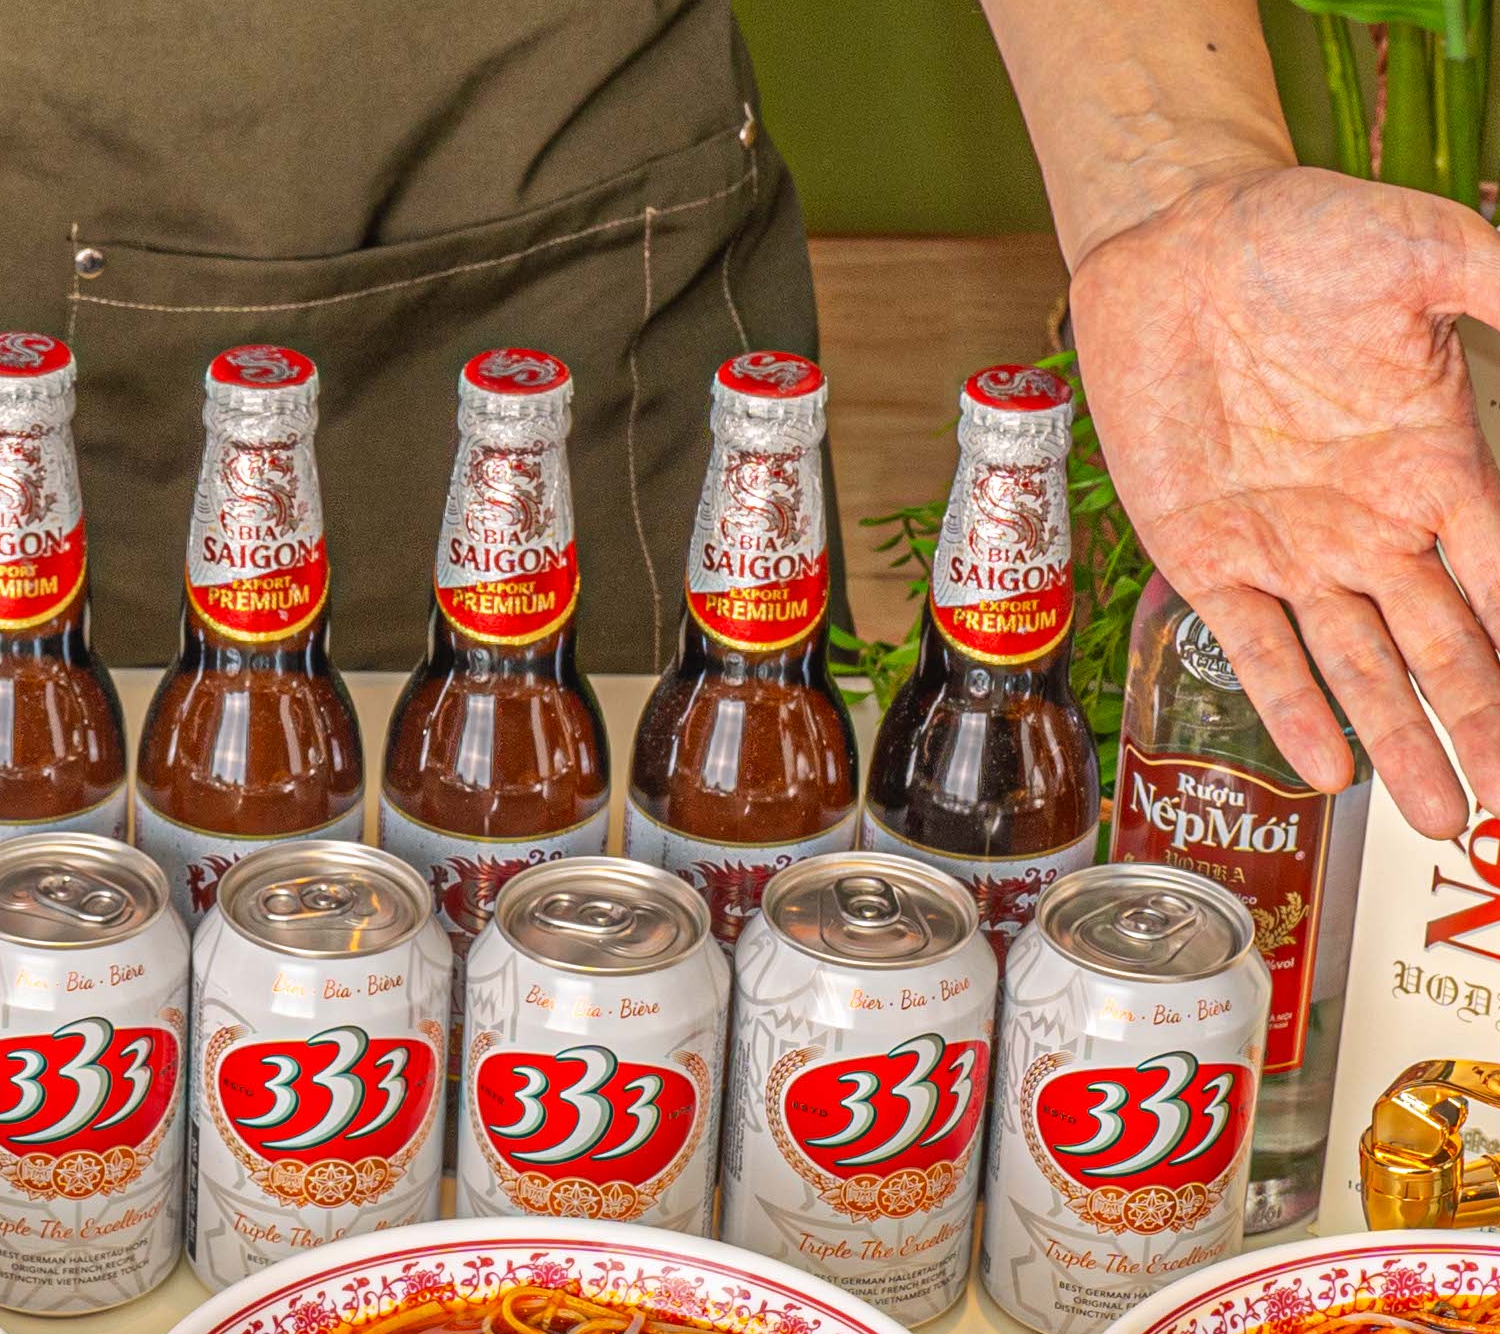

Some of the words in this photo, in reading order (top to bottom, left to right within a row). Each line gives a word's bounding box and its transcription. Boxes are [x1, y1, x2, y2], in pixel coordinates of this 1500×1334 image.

[238, 525, 277, 541] BIA
[484, 529, 522, 545] BIA
[739, 534, 778, 553] BIA
[203, 535, 316, 569] SAIGON
[449, 537, 563, 573] SAIGON
[702, 542, 817, 580] SAIGON
[988, 547, 1028, 564] BIA
[232, 575, 292, 590] EXPORT
[949, 556, 1064, 591] SAIGON
[208, 585, 310, 611] PREMIUM
[476, 581, 536, 595] EXPORT
[729, 587, 790, 601] EXPORT
[452, 589, 556, 615] PREMIUM
[705, 594, 808, 621] PREMIUM
[979, 599, 1039, 613] EXPORT
[953, 608, 1056, 633] PREMIUM
[1177, 771, 1245, 807] Rượu
[67, 970, 94, 992] Bia
[110, 964, 145, 987] Bière
[323, 978, 351, 1000] Bia
[368, 974, 404, 997] Bière
[619, 997, 660, 1019] Bière
[849, 989, 884, 1010] Bier
[901, 988, 927, 1010] Bia
[1153, 1002, 1182, 1026] Bia
[1197, 998, 1232, 1022] Bière
[235, 1025, 410, 1150] 333
[805, 1033, 976, 1167] 333
[489, 1045, 664, 1164] 333
[1054, 1051, 1234, 1177] 333
[40, 1219, 73, 1239] The
[233, 1211, 282, 1244] Triple
[289, 1227, 323, 1247] The
[21, 1254, 66, 1264] GERMAN
[69, 1247, 124, 1263] HALLERTAU
[126, 1237, 148, 1254] HOPS
[247, 1253, 269, 1265] BEST
[799, 1232, 852, 1261] Triple
[860, 1240, 894, 1260] The
[1044, 1237, 1097, 1269] Triple
[1105, 1253, 1140, 1274] The
[11, 1263, 60, 1275] ORIGINAL
[62, 1263, 103, 1275] FRENCH
[105, 1254, 135, 1269] RECIPE
[56, 1271, 118, 1286] VIETNAMESE
[120, 1259, 150, 1276] TOUCH
[841, 1273, 885, 1285] GERMAN
[888, 1264, 938, 1283] HALLERTAU
[847, 1284, 879, 1295] GINAL
[881, 1282, 920, 1295] FRENCH
[921, 1268, 947, 1285] RECIPE
[1058, 1281, 1082, 1294] BEST
[1085, 1288, 1131, 1299] GERMAN
[875, 1287, 931, 1305] VIETNAMESE
[1073, 1296, 1123, 1310] ORIGINAL
[1054, 1301, 1117, 1320] DISTINCTIVE
